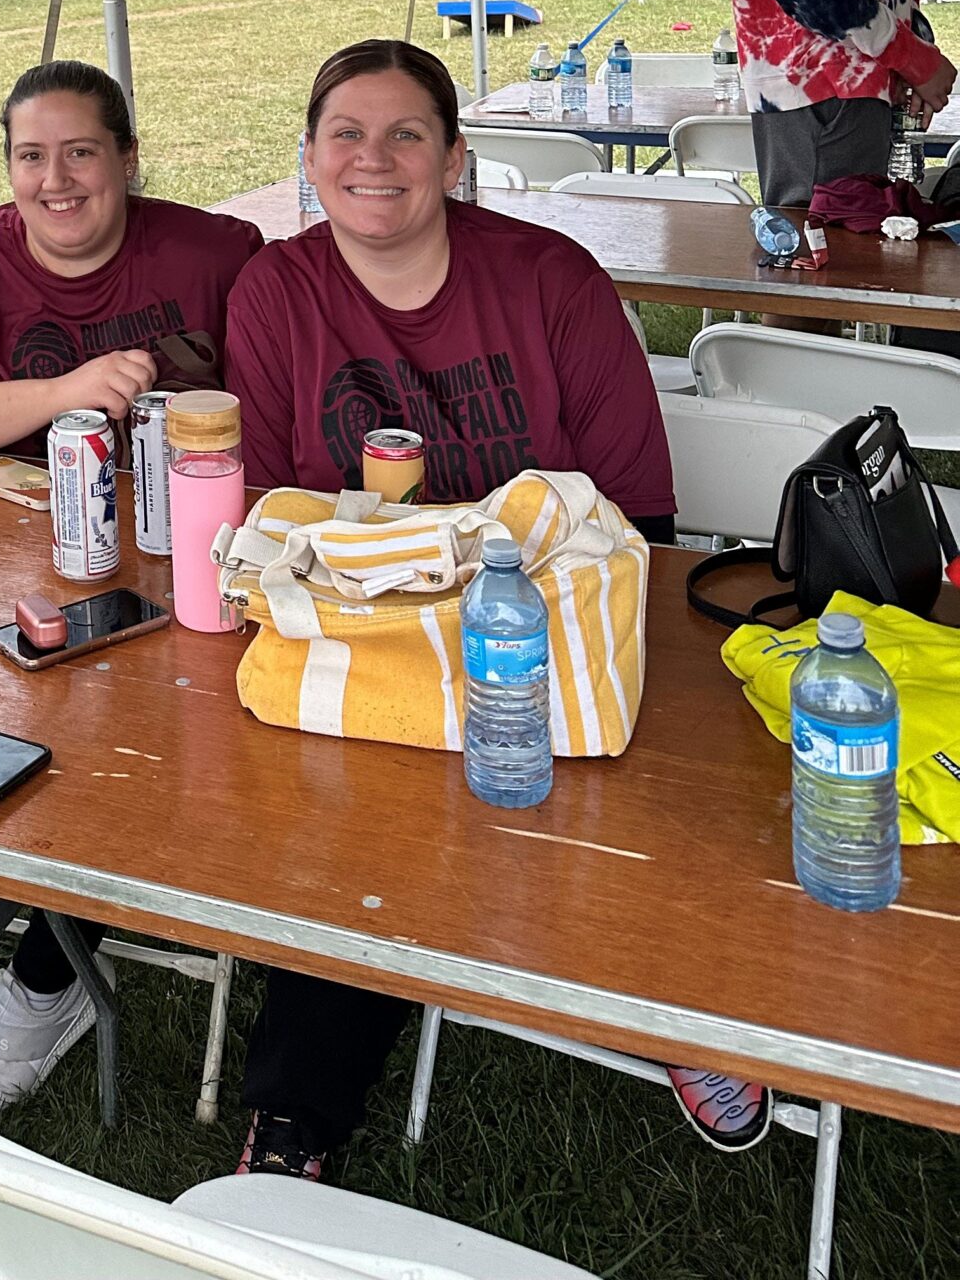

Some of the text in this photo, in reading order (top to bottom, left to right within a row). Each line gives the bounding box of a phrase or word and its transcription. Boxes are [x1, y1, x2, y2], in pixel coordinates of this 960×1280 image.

[80, 304, 163, 352] RUNNING
[161, 299, 185, 329] IN
[395, 352, 516, 400] RUNNING IN
[406, 387, 529, 441] BUFFALO
[92, 482, 113, 497] Blue
[424, 443, 473, 499] OR
[517, 646, 547, 661] SPRIN
